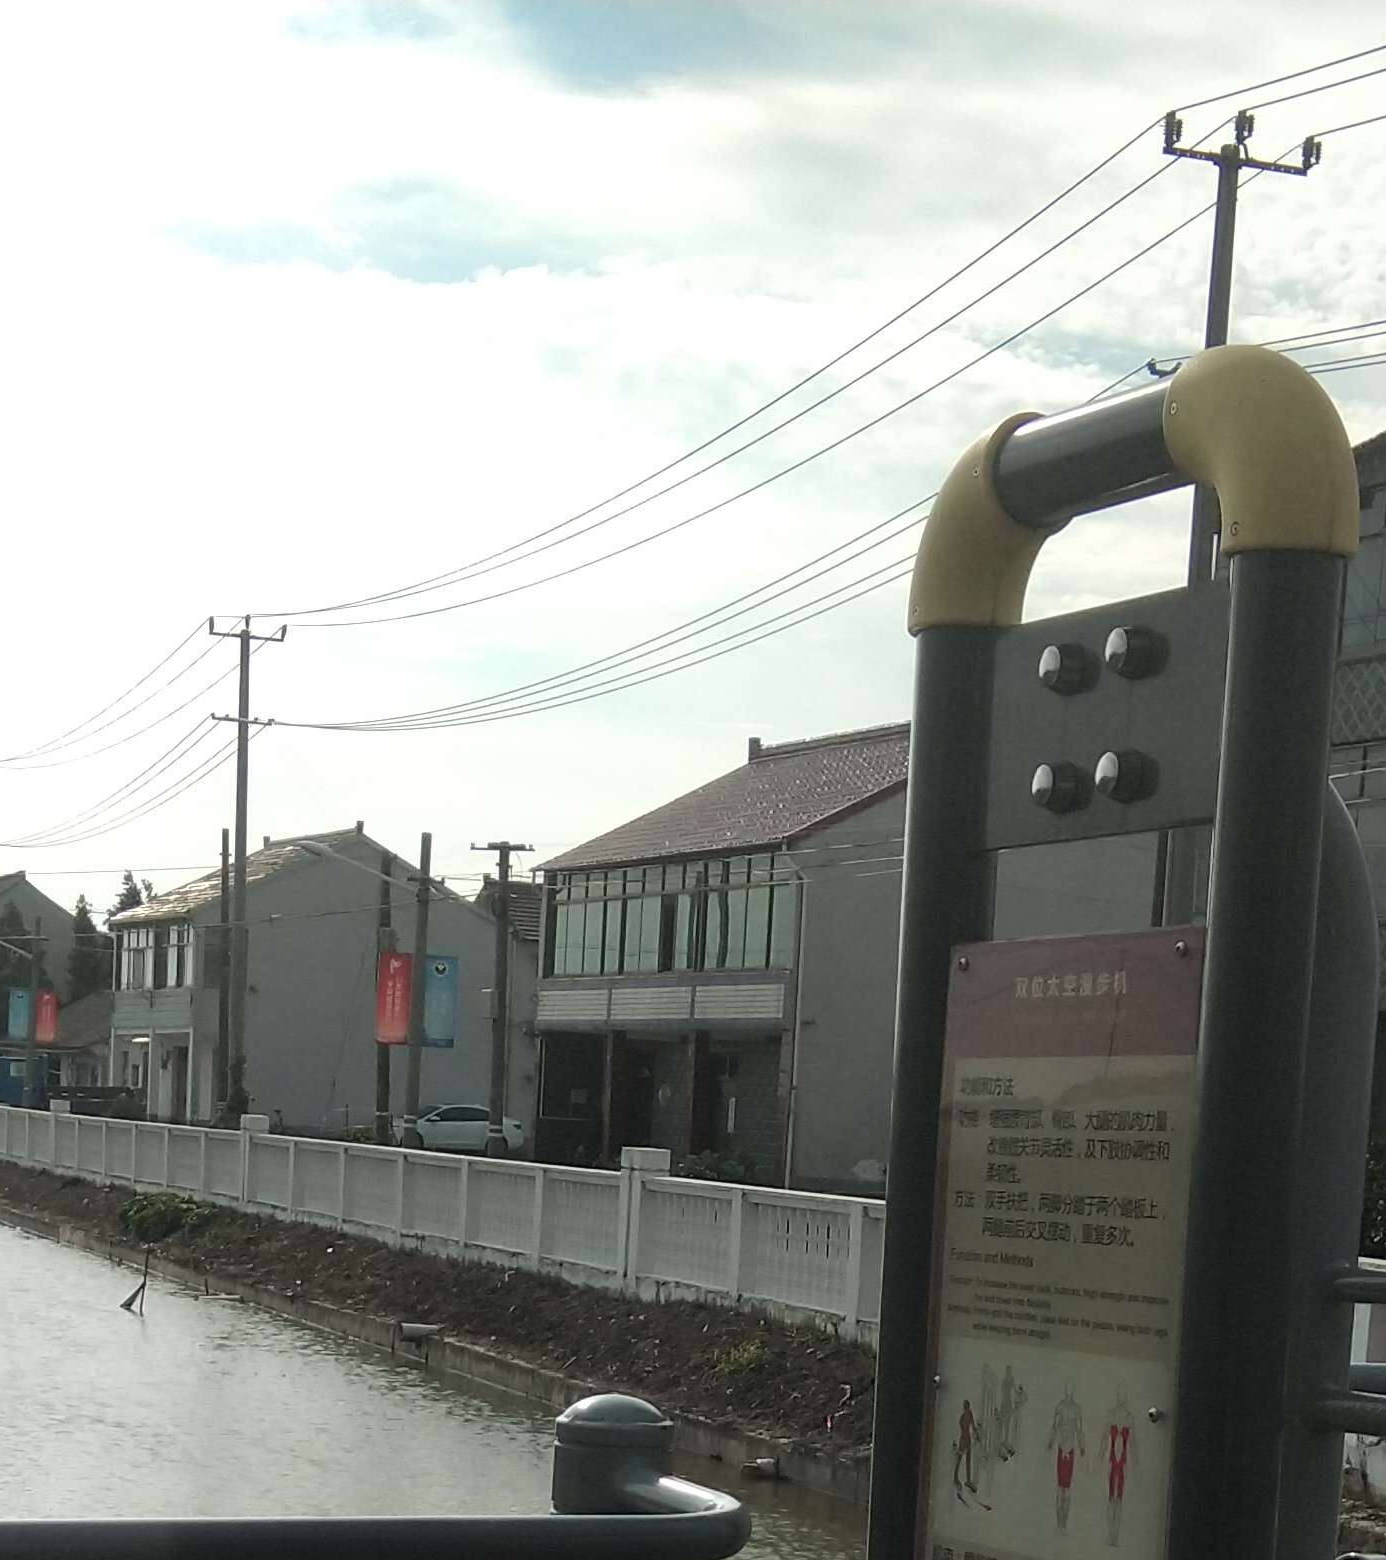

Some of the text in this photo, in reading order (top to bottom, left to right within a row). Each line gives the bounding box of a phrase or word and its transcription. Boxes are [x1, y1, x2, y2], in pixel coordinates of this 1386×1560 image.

[1015, 971, 1128, 998] 双位太空漫步机
[950, 1247, 982, 1262] Function
[983, 1253, 999, 1264] and
